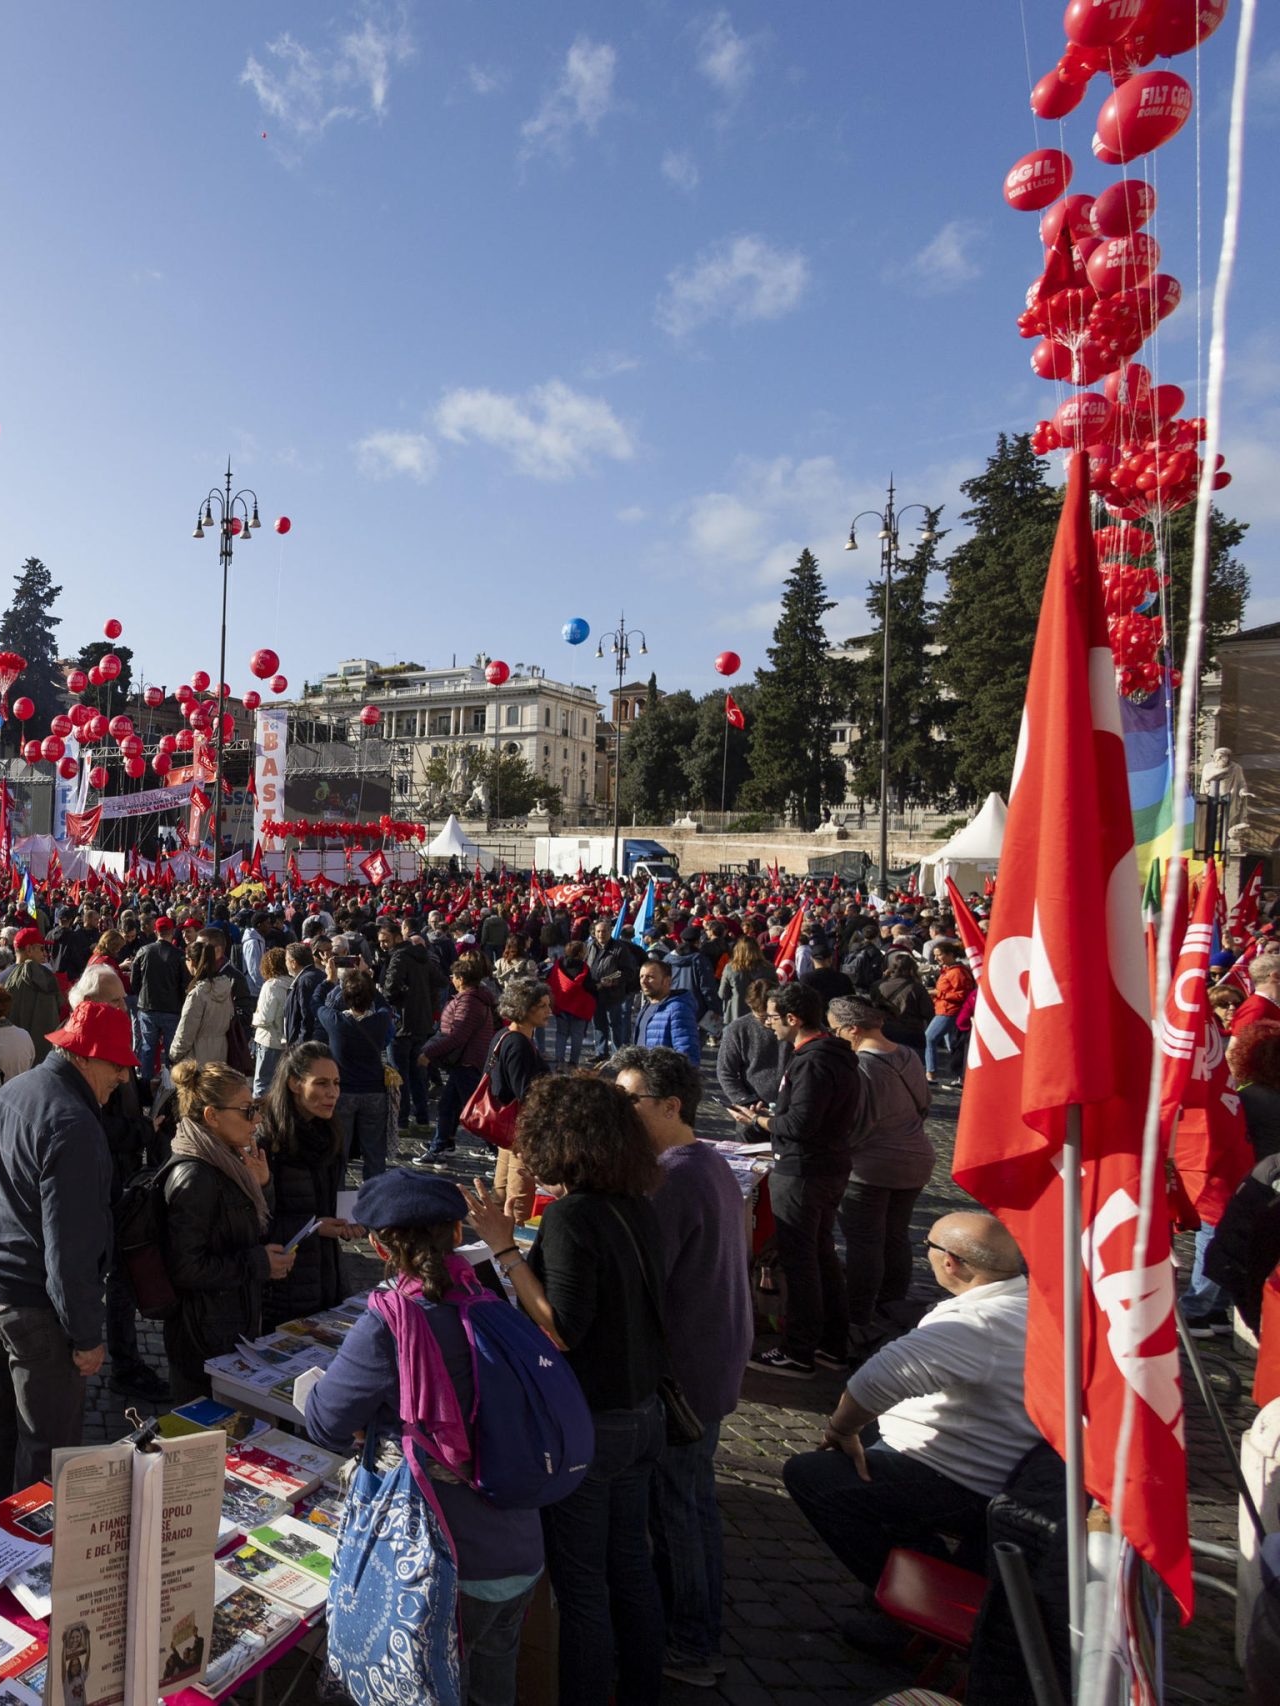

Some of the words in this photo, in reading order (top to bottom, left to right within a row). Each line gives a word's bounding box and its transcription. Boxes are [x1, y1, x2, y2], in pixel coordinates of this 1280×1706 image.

[1140, 85, 1168, 107] FILT
[1137, 106, 1164, 118] ROMA
[1007, 160, 1056, 188] CGIL
[1008, 186, 1026, 200] ROMA
[1033, 178, 1055, 189] LAZIO
[1082, 402, 1105, 416] CGIL
[261, 733, 279, 852] BASTA
[127, 805, 152, 816] UNICA
[153, 800, 179, 810] UNITA
[108, 1459, 127, 1477] LA
[90, 1523, 97, 1535] A
[163, 1504, 192, 1517] OPOLO
[85, 1549, 92, 1559] E
[95, 1544, 111, 1558] DEL
